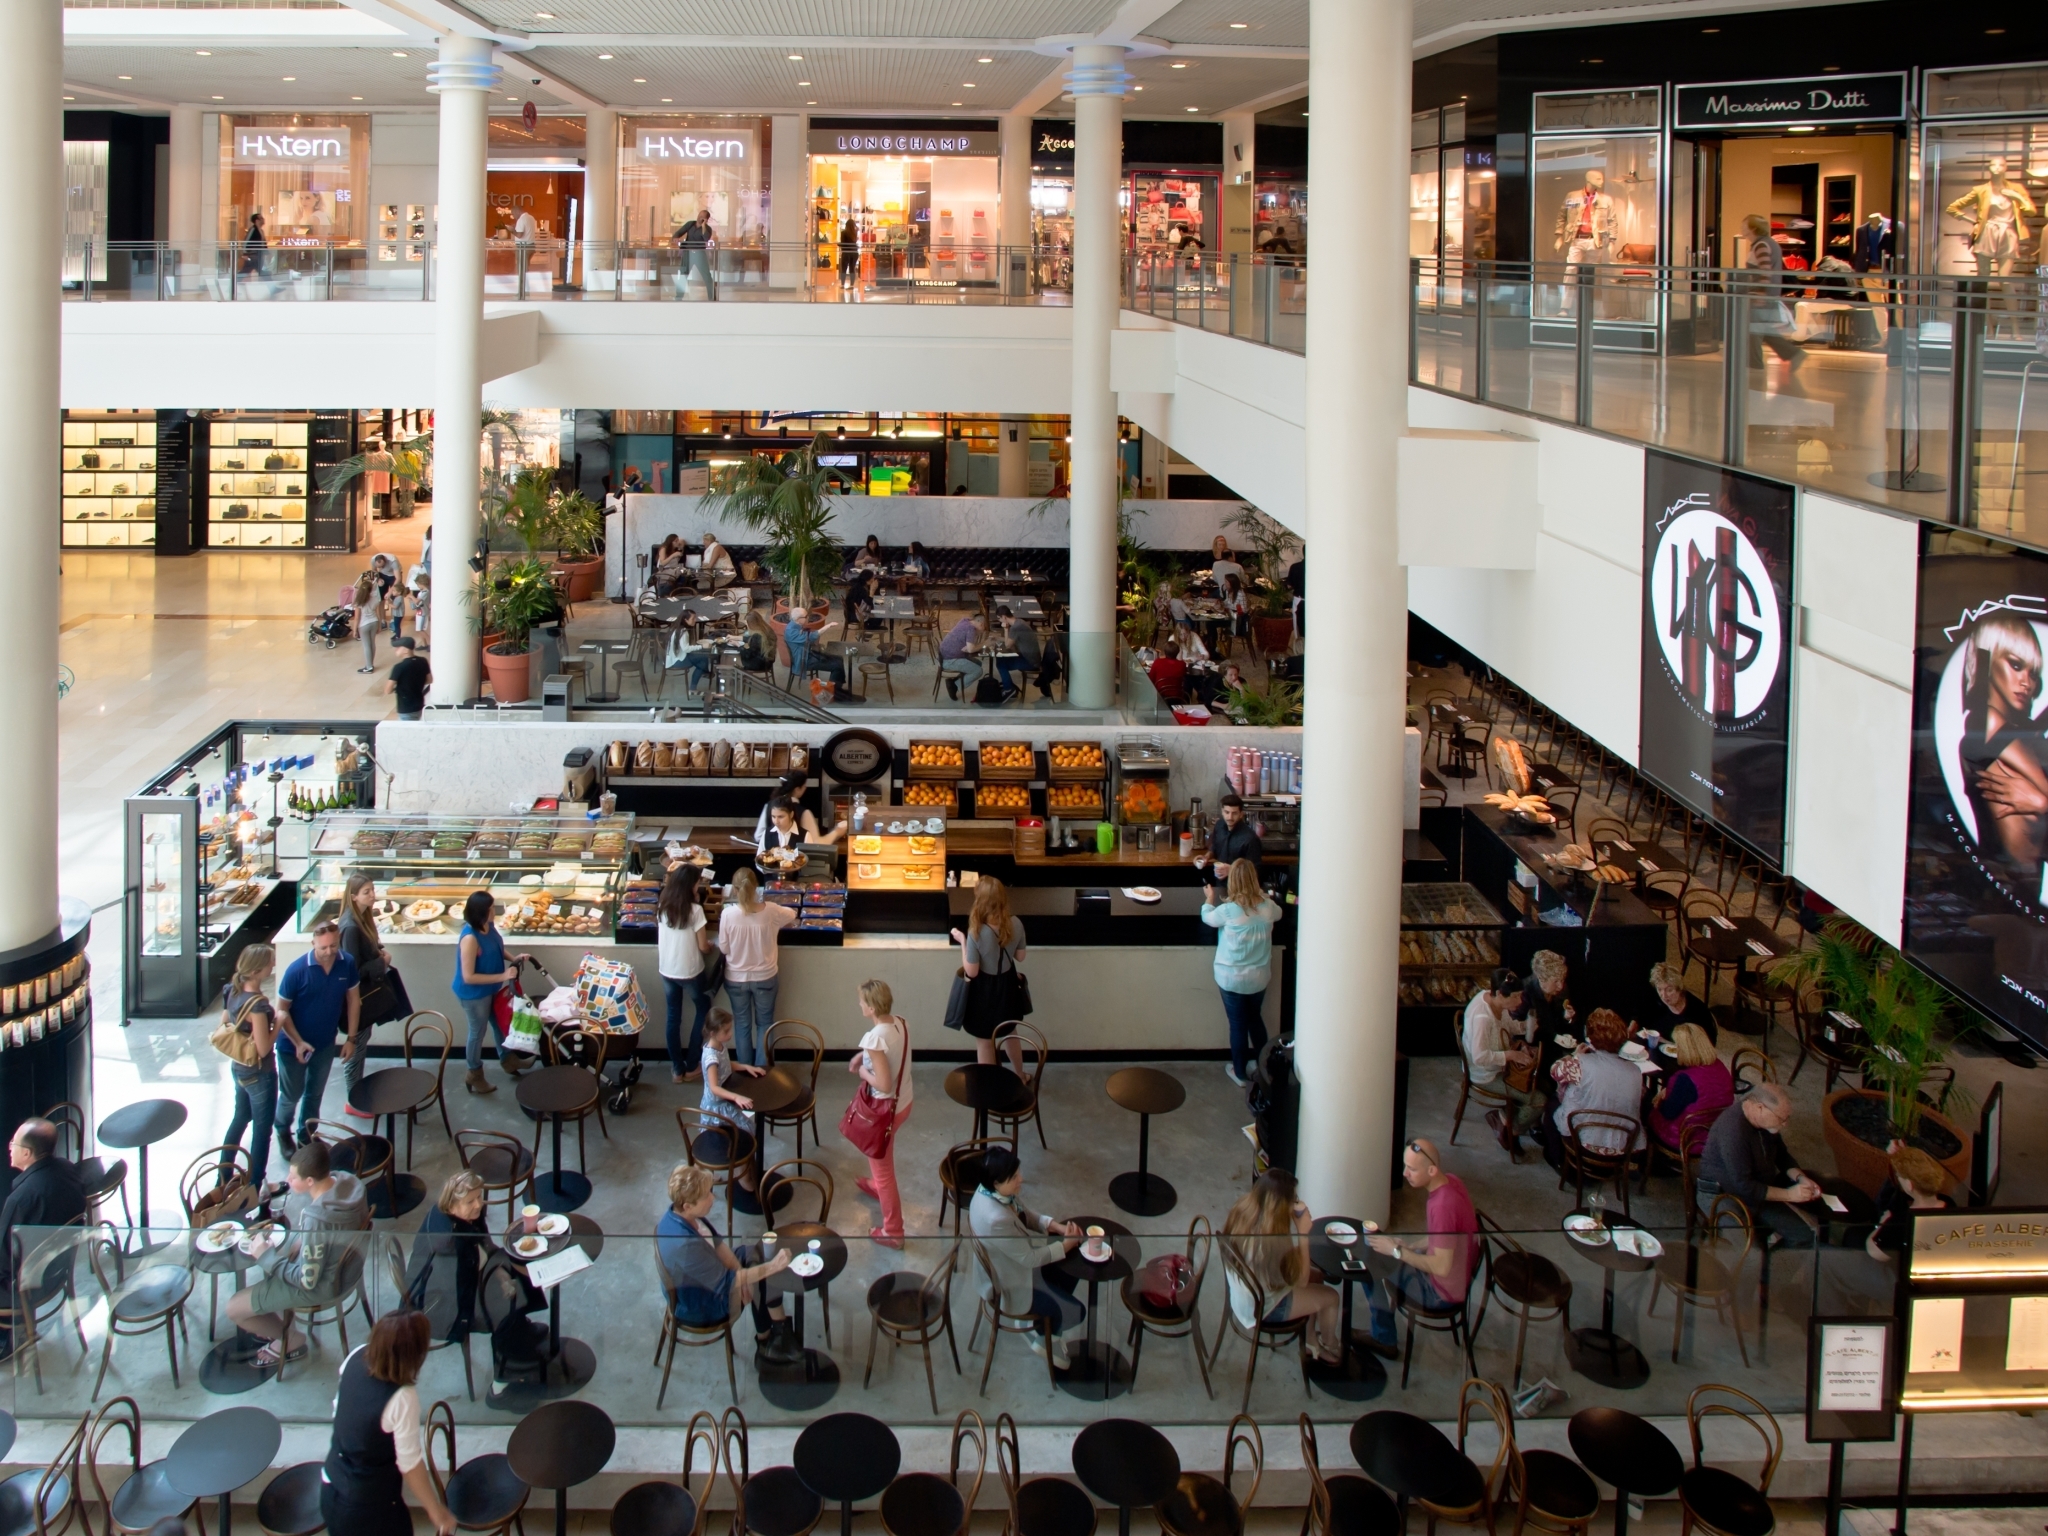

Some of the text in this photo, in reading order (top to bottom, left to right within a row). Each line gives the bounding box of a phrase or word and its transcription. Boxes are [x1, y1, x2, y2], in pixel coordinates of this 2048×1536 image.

[1705, 89, 1870, 115] Massimo Dutti
[838, 136, 970, 151] LONGCHAMP
[2000, 973, 2046, 1009] רמת אביב
[1968, 1239, 2036, 1249] BRASSERIE
